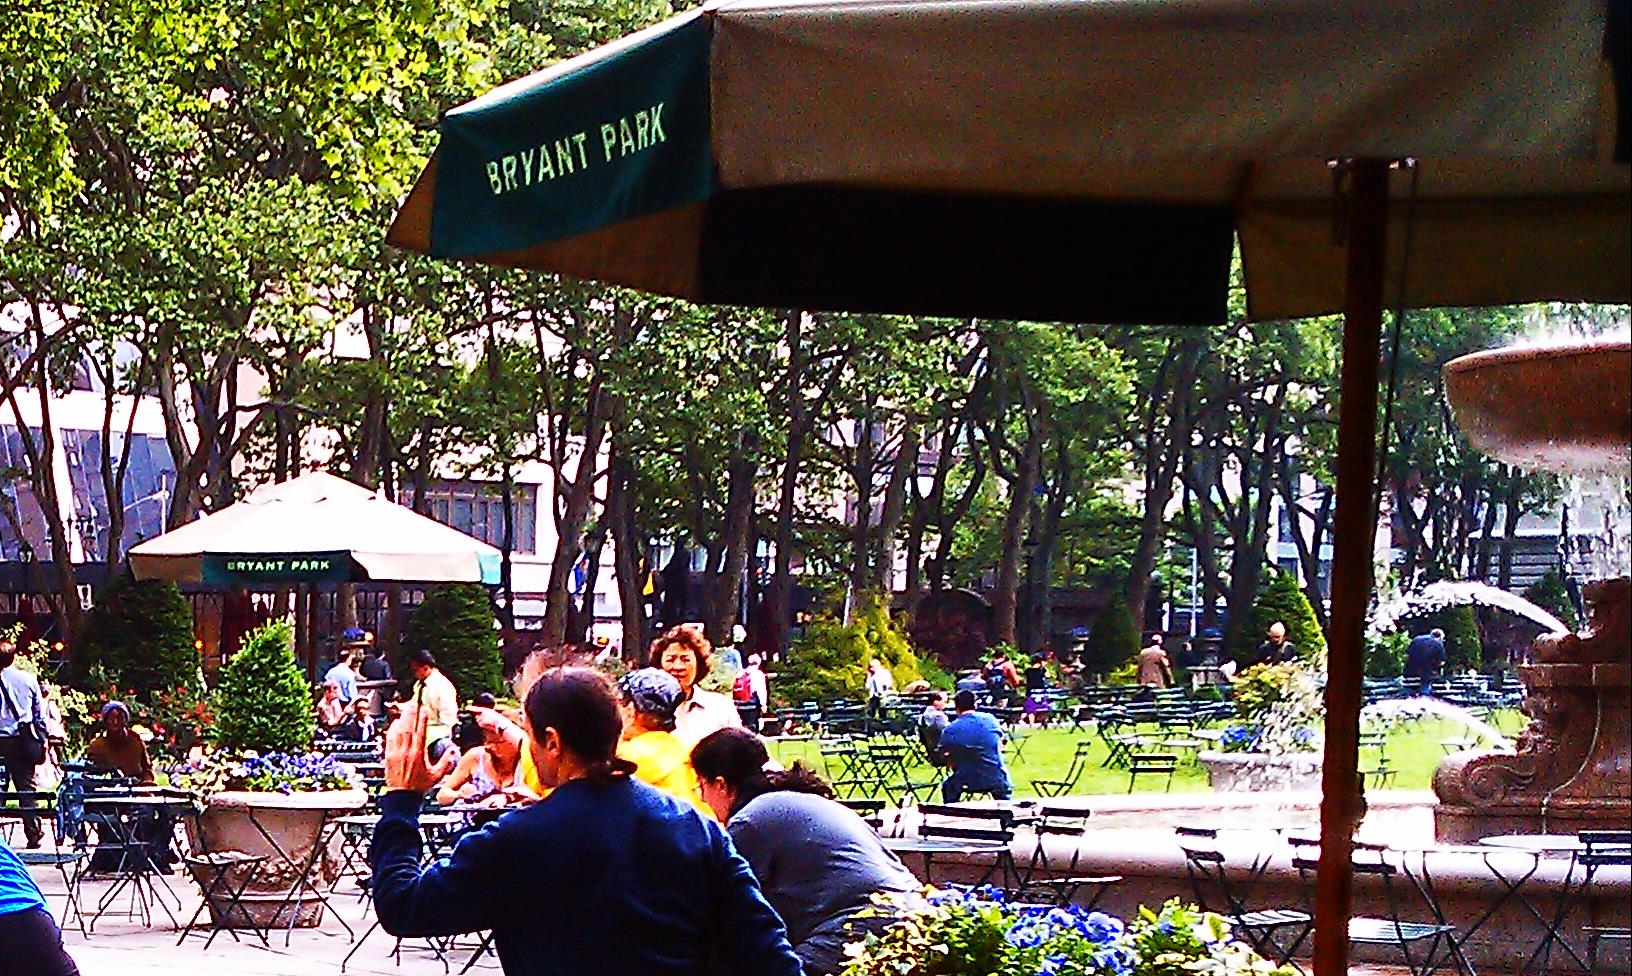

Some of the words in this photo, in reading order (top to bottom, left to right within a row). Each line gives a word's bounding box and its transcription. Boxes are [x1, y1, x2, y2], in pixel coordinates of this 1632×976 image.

[485, 131, 588, 195] BRYANT
[600, 102, 667, 163] PARK
[227, 561, 285, 571] BRYANT
[291, 560, 330, 571] PARK
